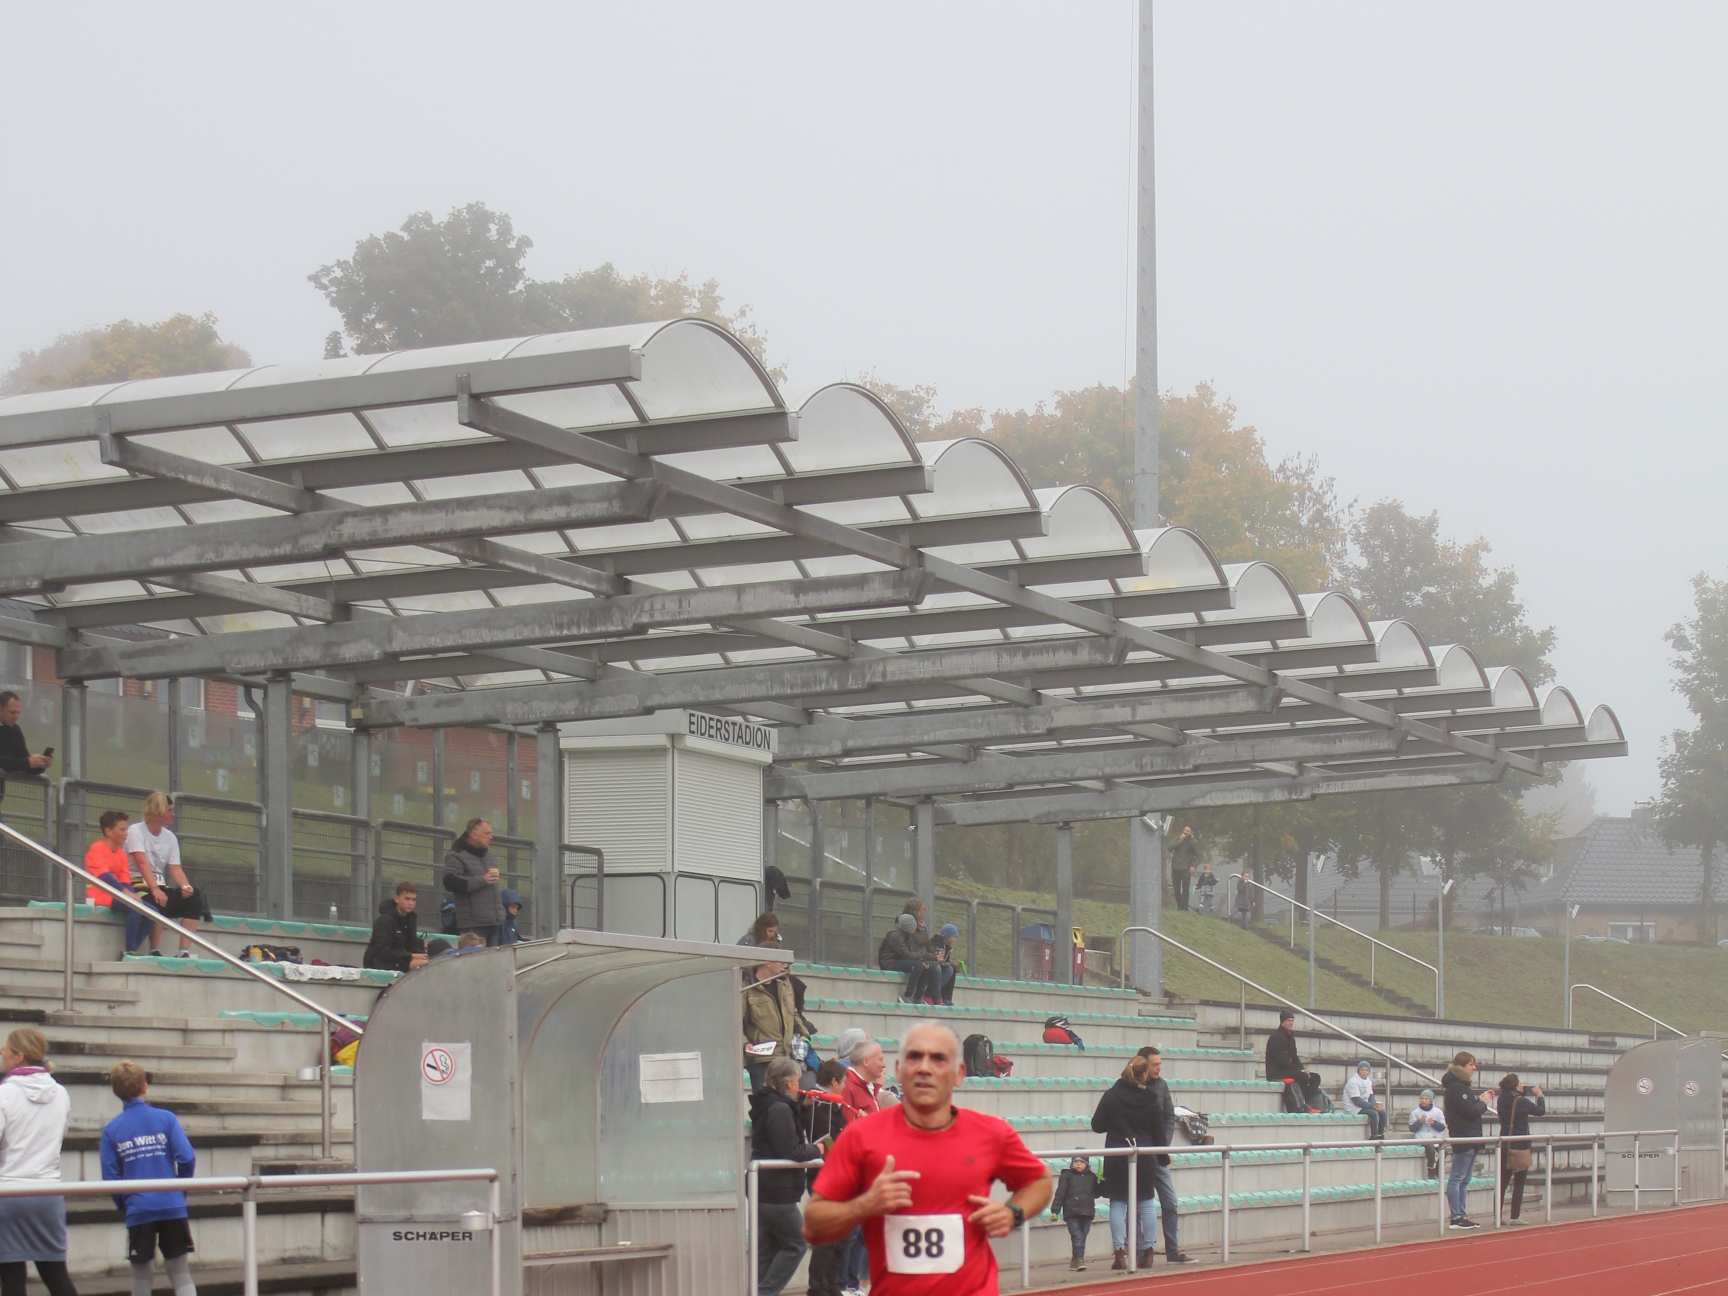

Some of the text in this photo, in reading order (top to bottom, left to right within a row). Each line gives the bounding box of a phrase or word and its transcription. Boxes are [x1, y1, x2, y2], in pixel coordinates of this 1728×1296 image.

[688, 712, 771, 750] EIDERSTADION
[133, 1134, 157, 1147] Witt
[392, 1231, 473, 1241] SCHÄPER
[902, 1227, 945, 1259] 88
